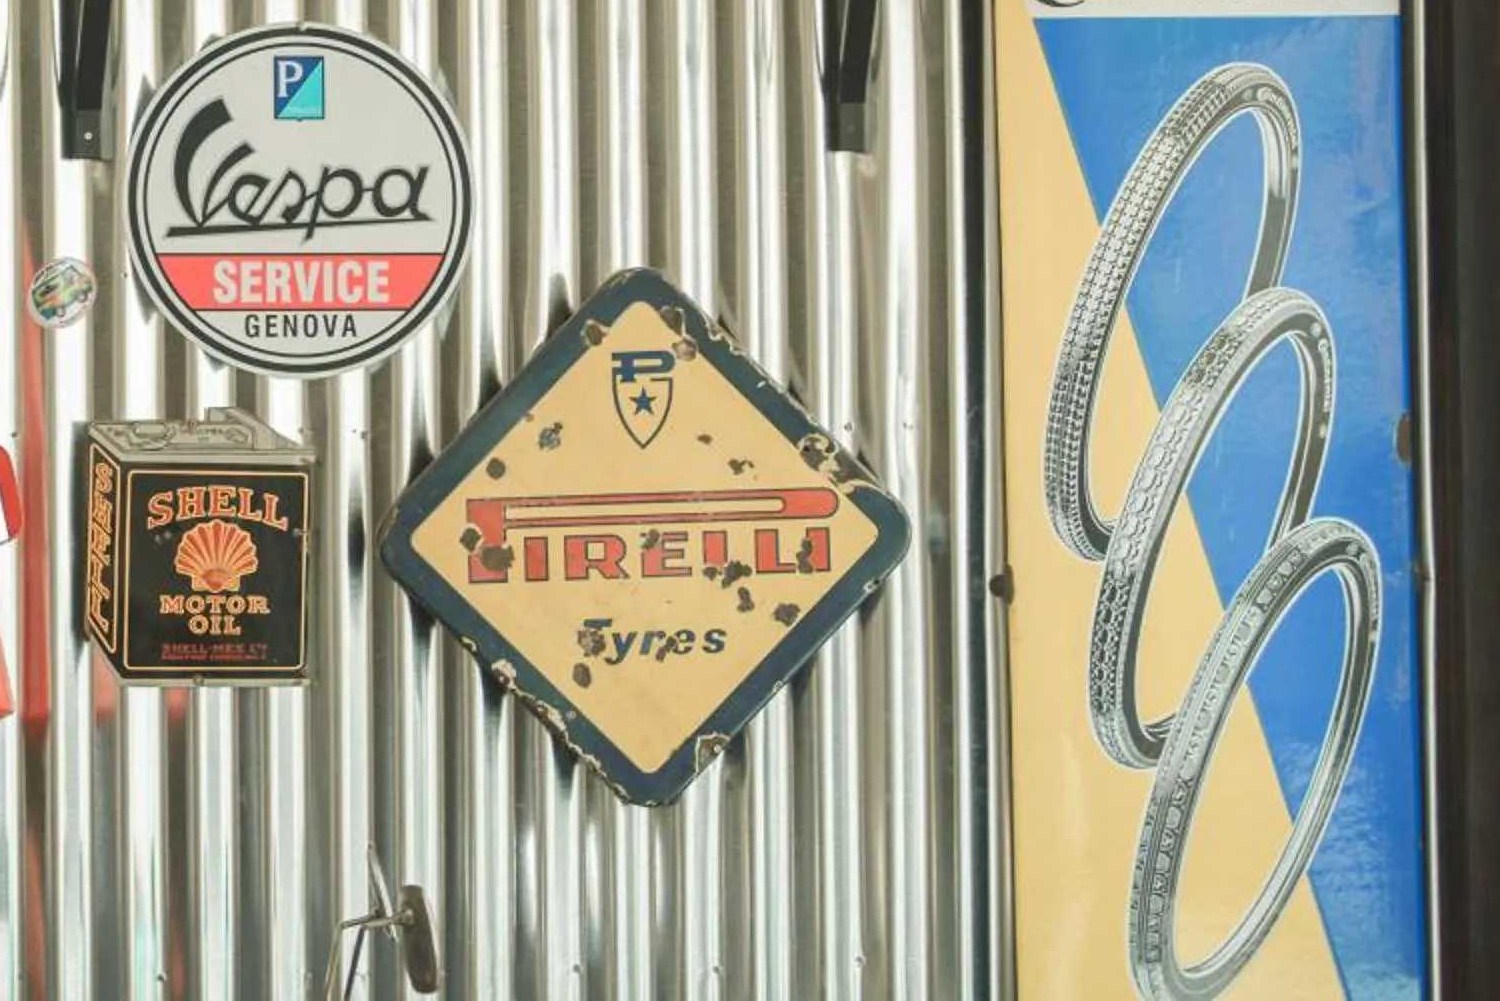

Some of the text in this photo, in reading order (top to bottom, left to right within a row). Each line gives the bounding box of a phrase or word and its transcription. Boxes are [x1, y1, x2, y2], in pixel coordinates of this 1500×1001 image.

[166, 94, 437, 245] Vespa
[212, 259, 390, 305] SERVICE
[244, 313, 358, 339] GENOVA
[147, 485, 288, 531] SHELL
[466, 486, 839, 584] PIRELLI
[159, 594, 270, 614] MOTOR
[187, 615, 242, 636] OIL
[579, 618, 728, 666] Tyres
